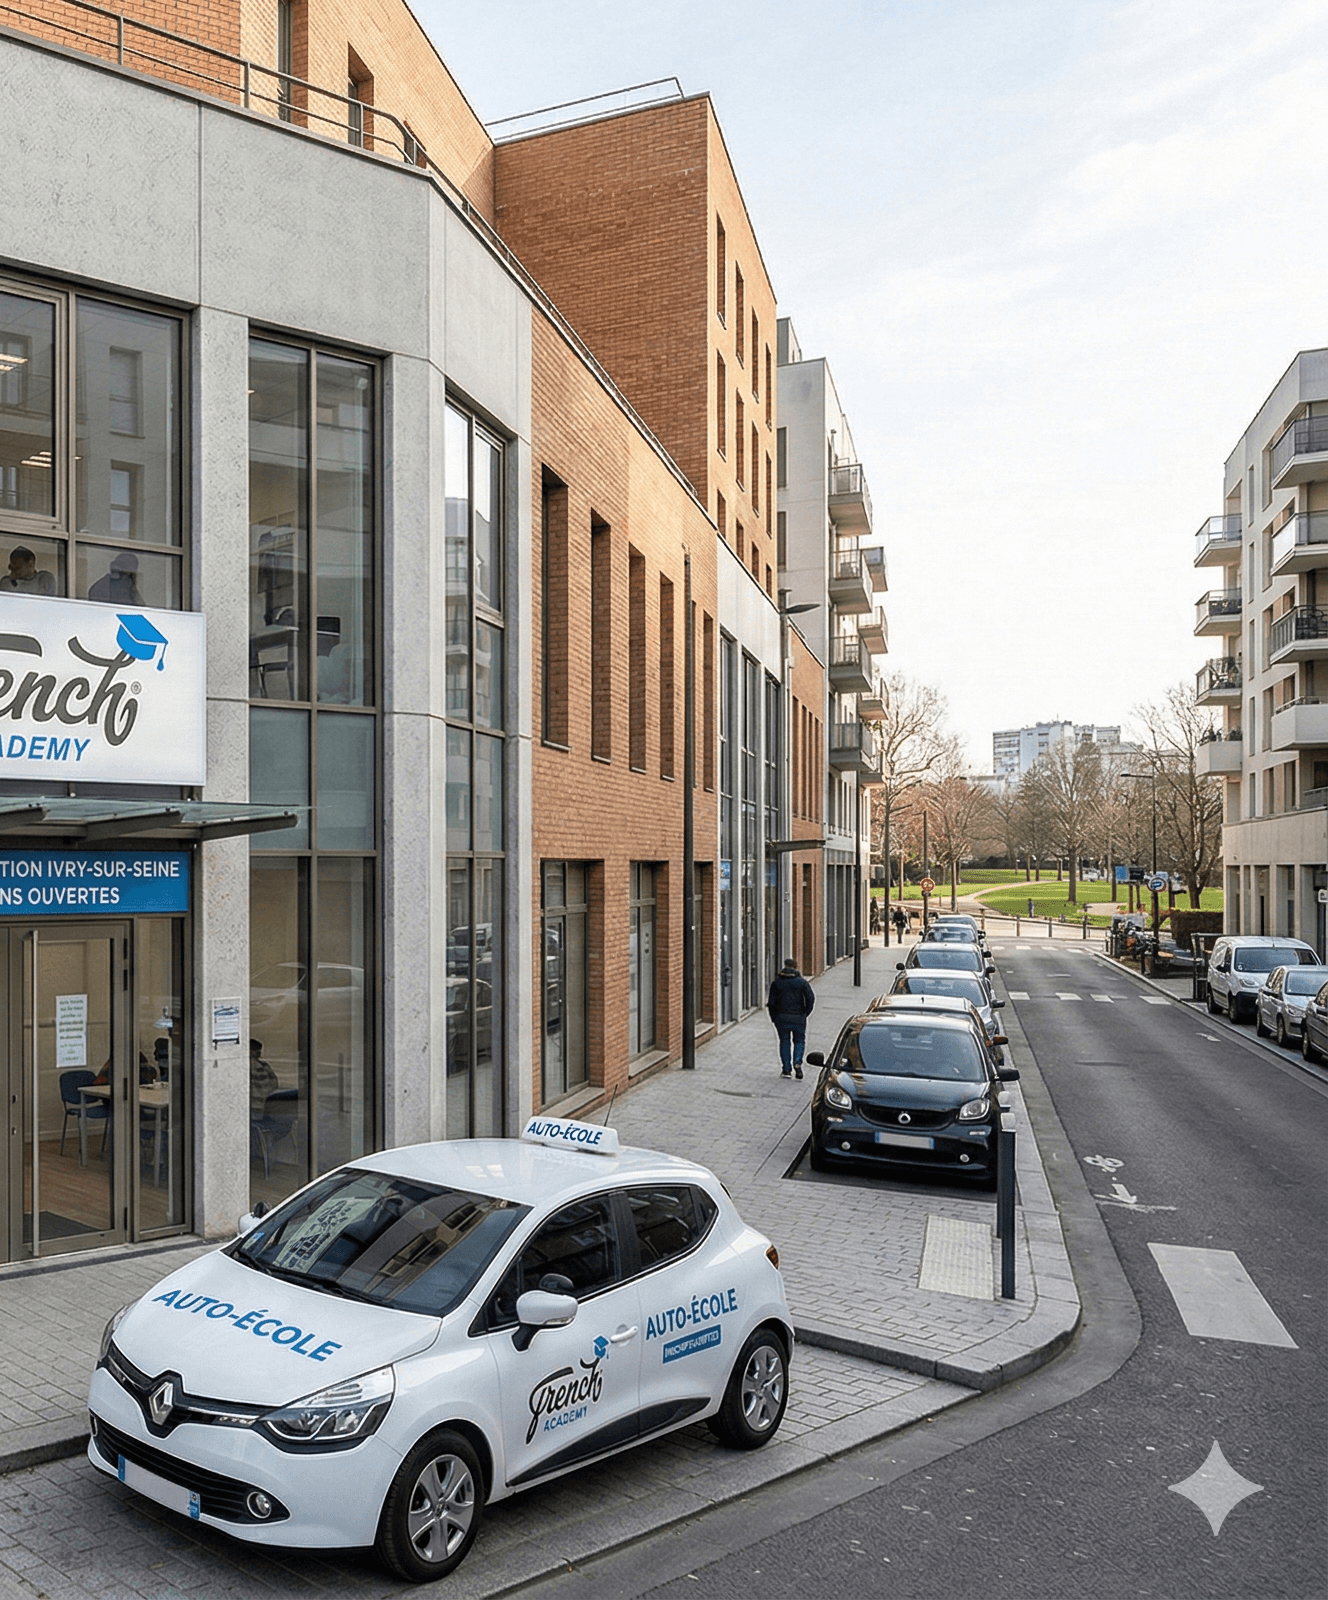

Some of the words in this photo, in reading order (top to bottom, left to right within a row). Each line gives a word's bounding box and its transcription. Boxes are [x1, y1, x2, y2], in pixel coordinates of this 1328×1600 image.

[48, 860, 180, 878] IVRY-SUR-SEINE
[27, 887, 120, 905] OUVERTES
[527, 1122, 603, 1145] AUTO-ÉCOLE
[151, 1289, 343, 1362] AUTO-ÉCOLE
[645, 1287, 738, 1341] AUTO-ÉCOLE
[543, 1405, 588, 1432] ACADEMY
